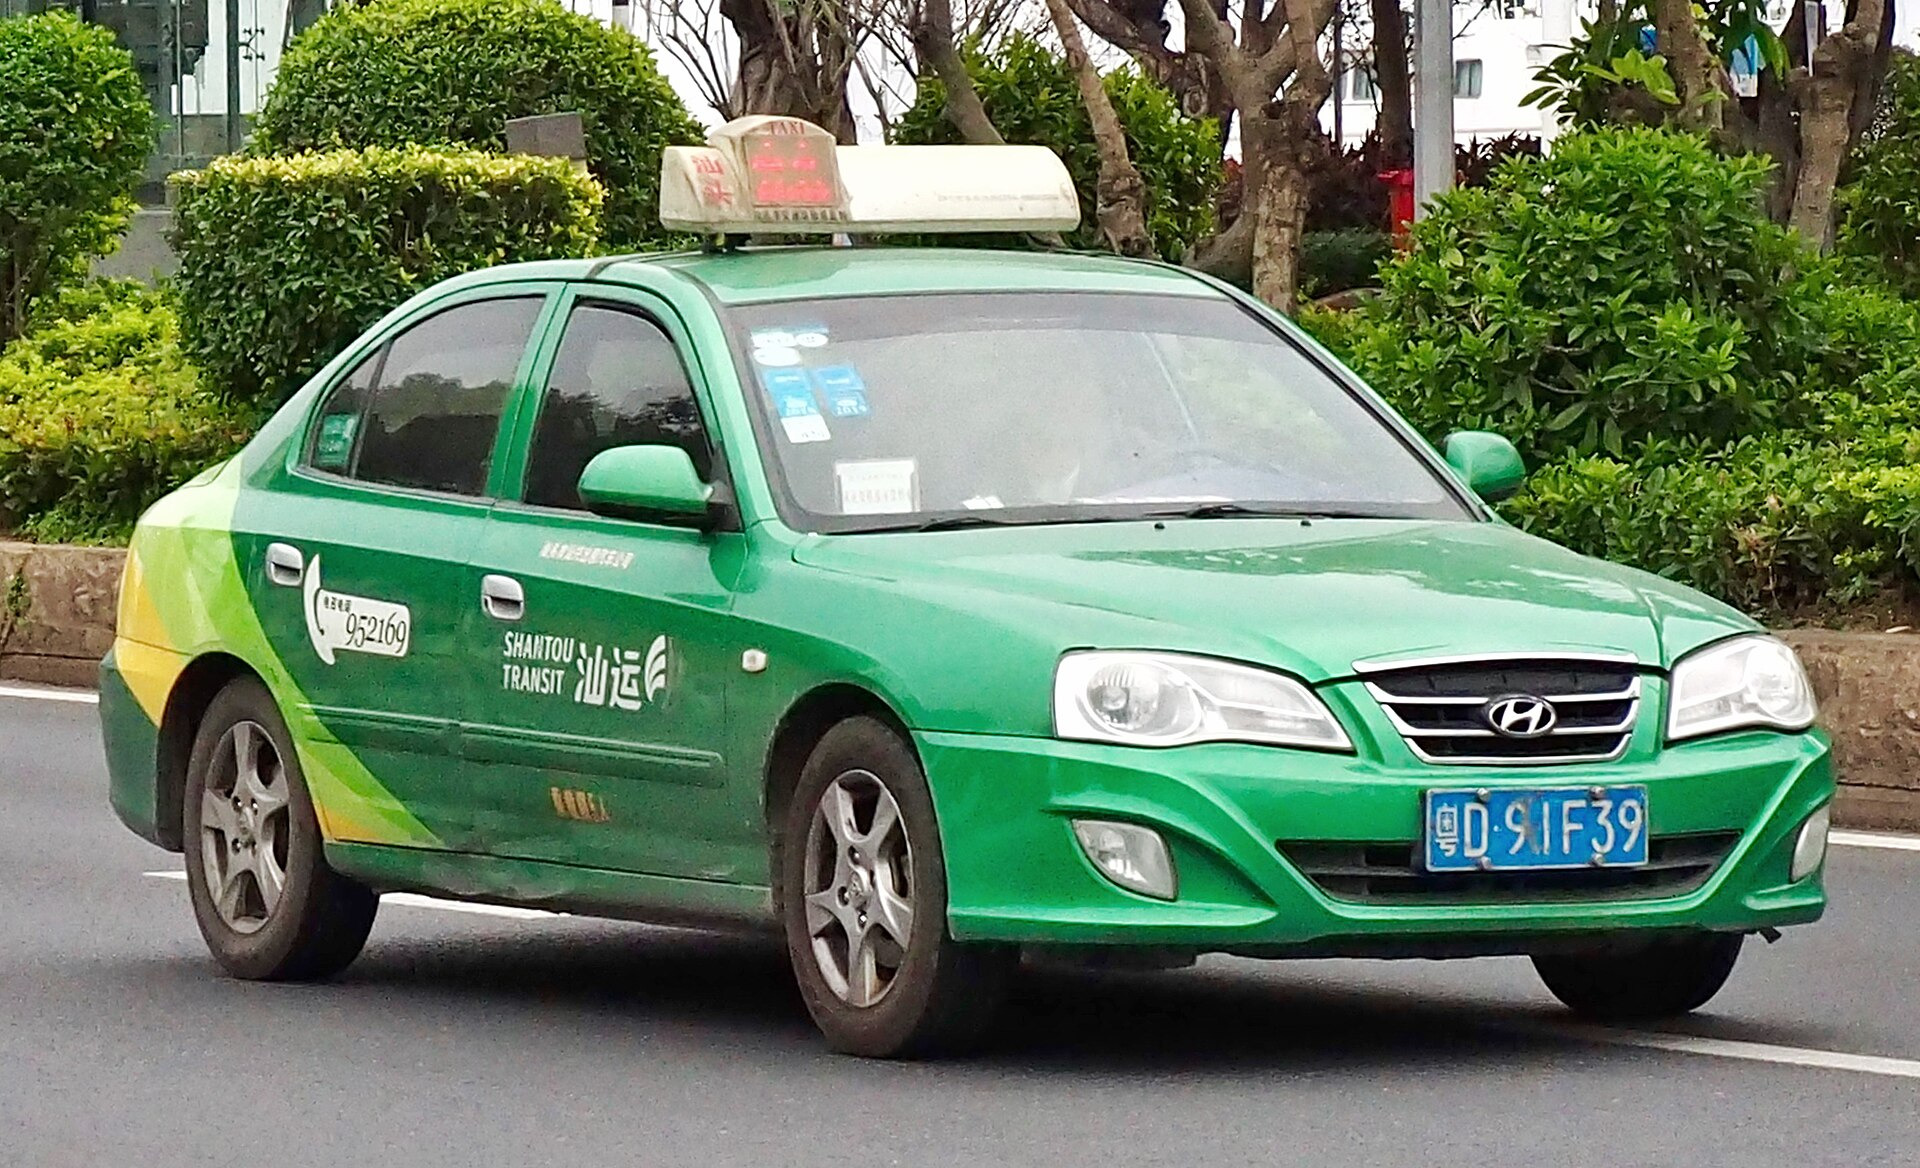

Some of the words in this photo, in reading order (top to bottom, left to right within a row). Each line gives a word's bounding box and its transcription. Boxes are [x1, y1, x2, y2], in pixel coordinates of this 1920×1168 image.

[770, 121, 805, 135] TAXI
[345, 611, 407, 654] 952169
[503, 631, 575, 663] SHANTOU
[502, 664, 565, 695] TRANSIT
[574, 642, 642, 711] 汕运
